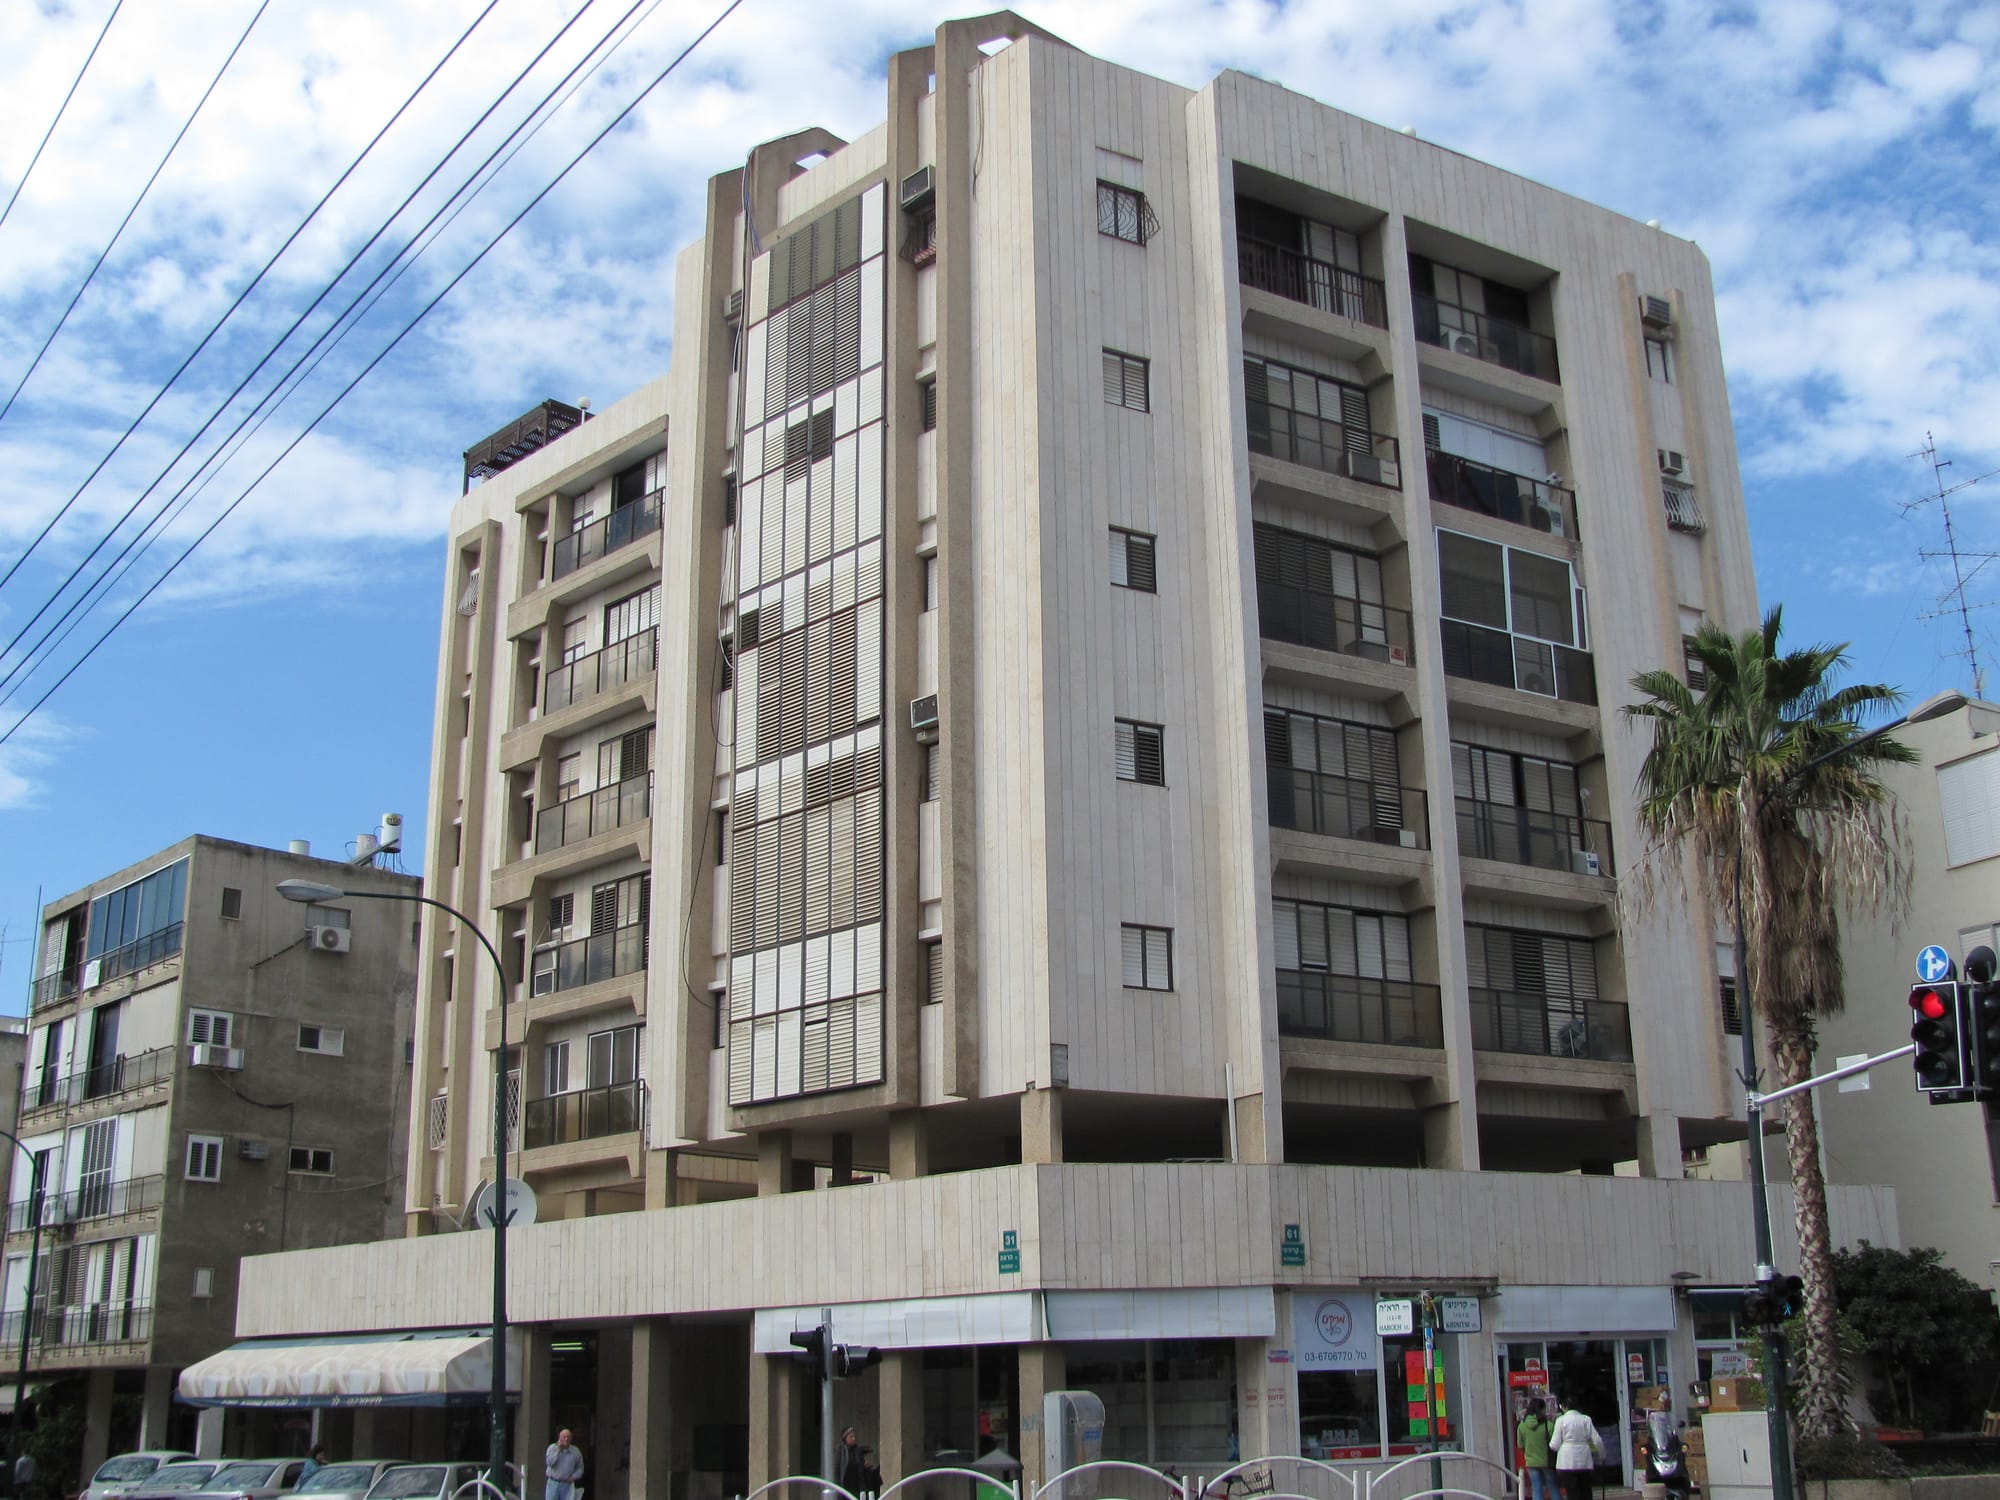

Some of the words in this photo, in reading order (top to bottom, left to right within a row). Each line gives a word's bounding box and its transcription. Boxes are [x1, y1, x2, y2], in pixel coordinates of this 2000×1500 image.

[1287, 1229, 1297, 1239] 61
[1005, 1235, 1015, 1246] 31
[1304, 1351, 1353, 1361] 03-6706770
